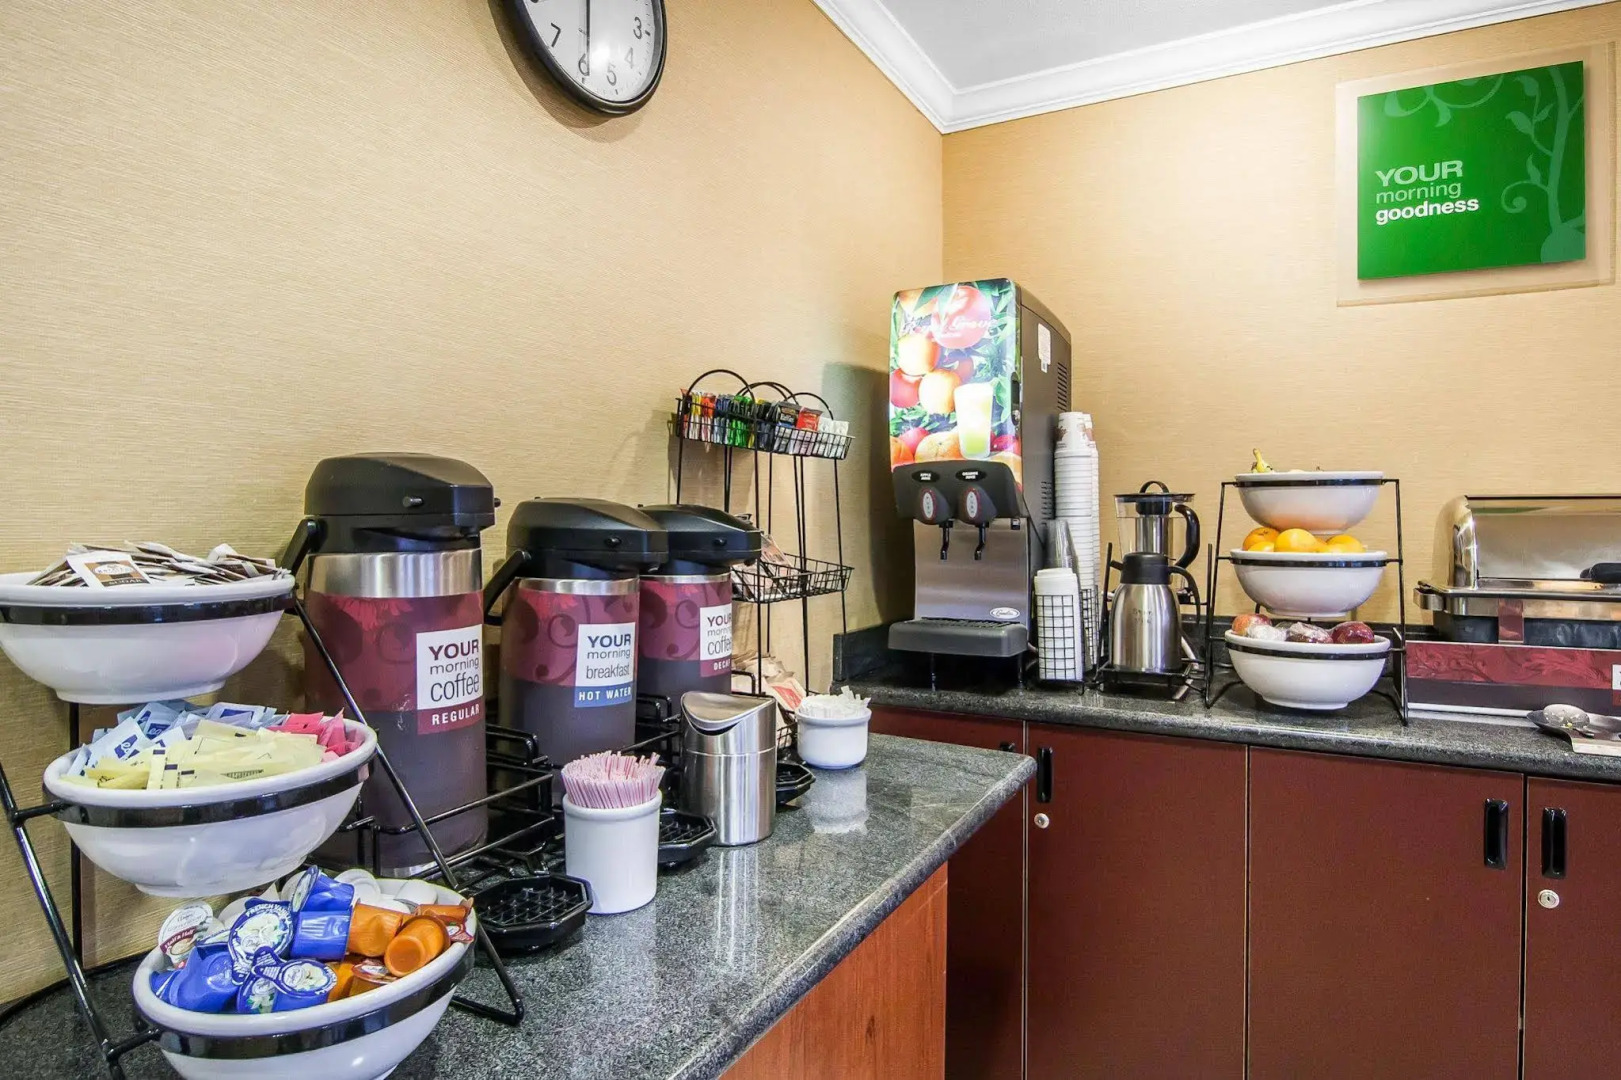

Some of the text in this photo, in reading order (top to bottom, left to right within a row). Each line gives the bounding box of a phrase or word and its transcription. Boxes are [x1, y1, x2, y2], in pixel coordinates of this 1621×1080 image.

[550, 22, 561, 47] 7
[633, 16, 643, 40] 3
[578, 53, 590, 76] 6
[624, 47, 634, 69] 4
[606, 64, 617, 86] 5
[1375, 159, 1463, 187] YOUR
[1376, 181, 1462, 204] morning
[1375, 197, 1480, 226] goodness
[428, 638, 480, 662] YOUR
[587, 632, 632, 649] YOUR
[586, 646, 631, 661] morning
[429, 656, 480, 676] morning
[585, 661, 631, 680] breakfast
[429, 671, 480, 703] coffee
[578, 686, 632, 702] HOT WATER
[431, 703, 480, 726] REGULAR
